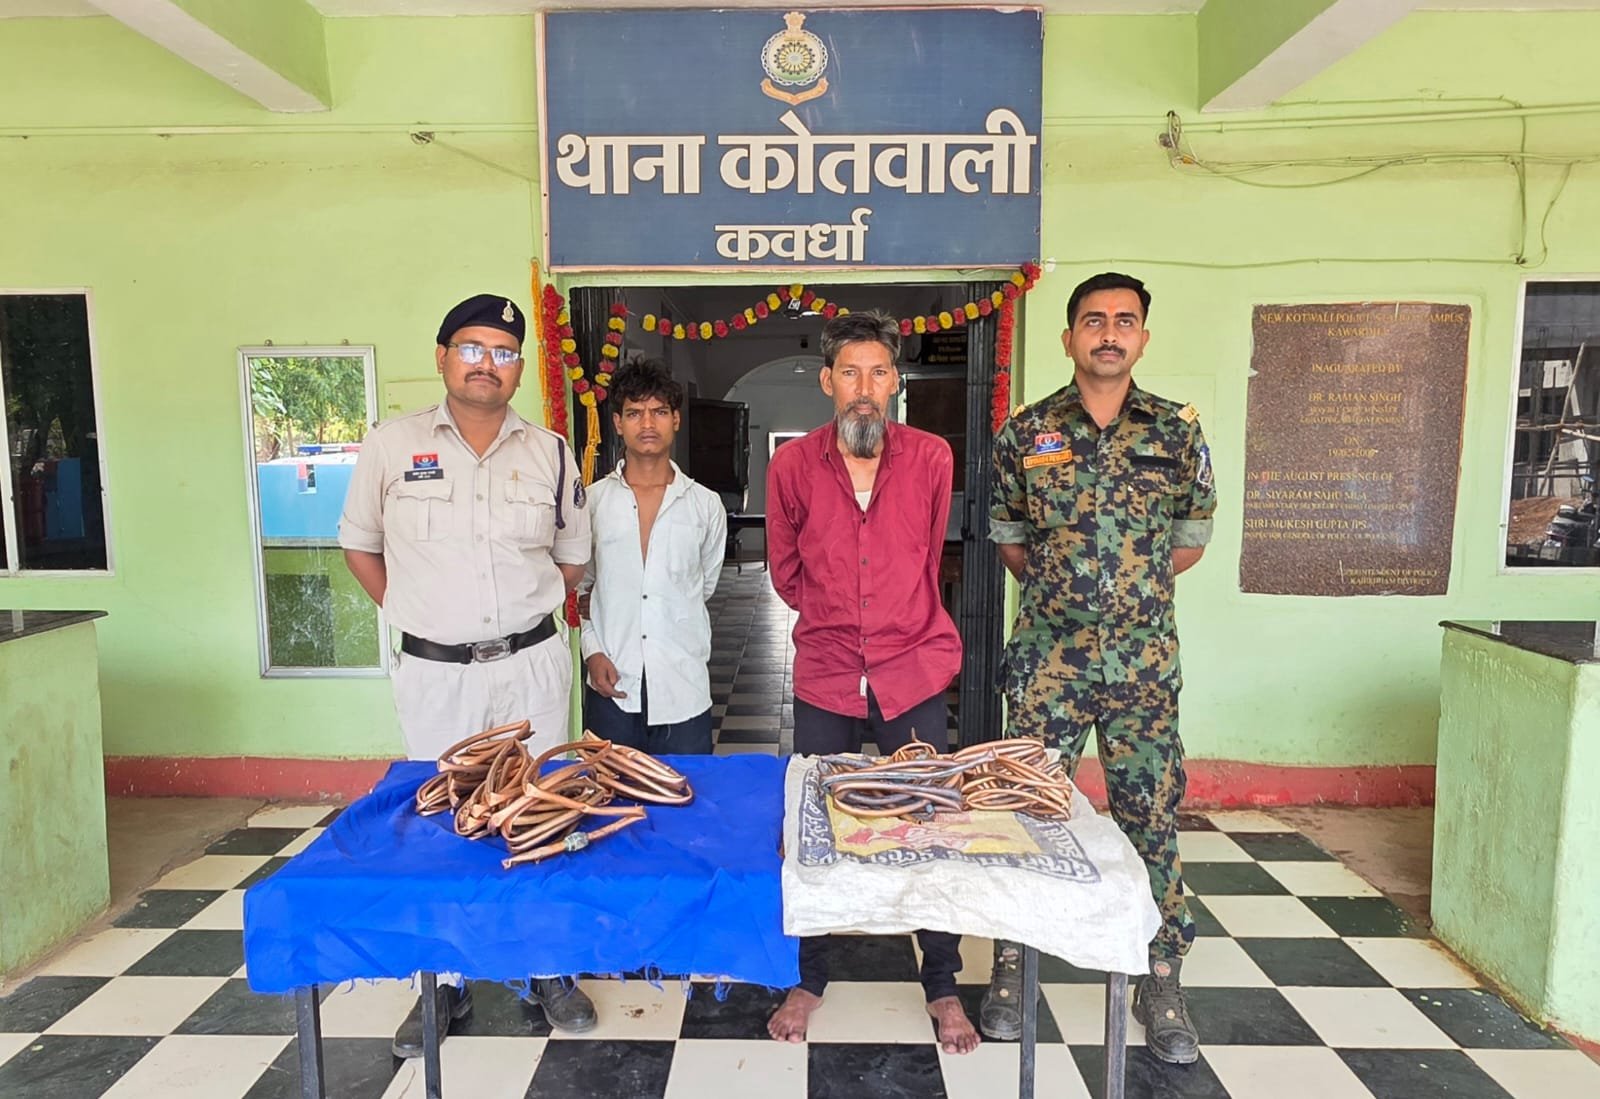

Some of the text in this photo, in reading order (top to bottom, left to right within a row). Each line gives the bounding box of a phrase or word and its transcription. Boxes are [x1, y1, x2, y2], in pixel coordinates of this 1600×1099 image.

[556, 108, 1037, 195] थाना कोतवाली
[714, 207, 873, 261] कवर्धा
[1344, 437, 1360, 445] ON
[1247, 472, 1259, 480] IN
[1261, 472, 1281, 480] THE
[1282, 472, 1324, 480] AUGUST
[1270, 519, 1314, 529] MUKESH
[1315, 519, 1350, 529] GUPTA
